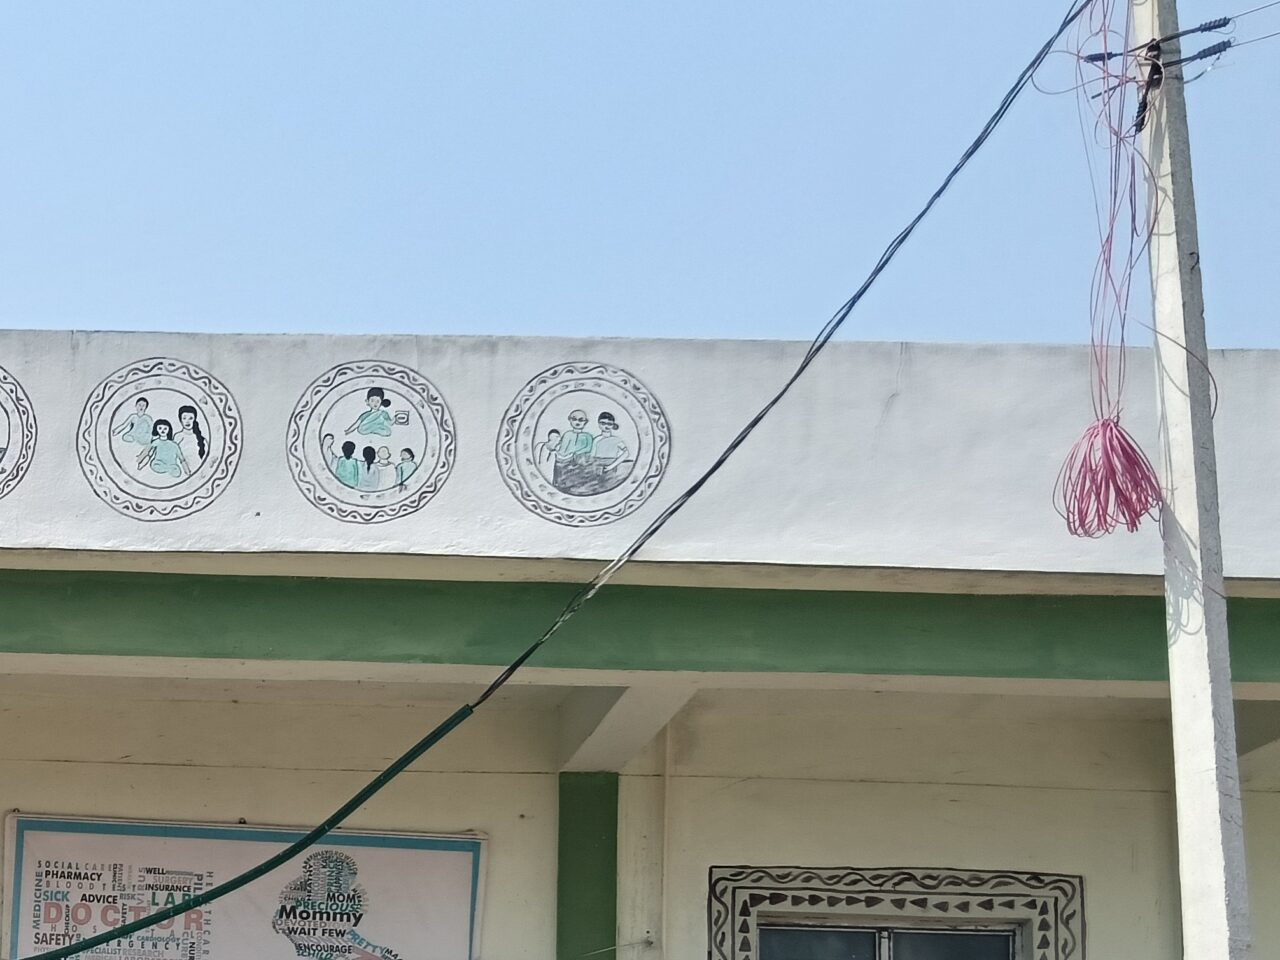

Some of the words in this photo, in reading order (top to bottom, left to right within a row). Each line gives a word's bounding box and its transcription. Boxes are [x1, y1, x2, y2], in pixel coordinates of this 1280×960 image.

[37, 860, 80, 871] SOCIAL
[44, 870, 103, 881] PHARMACY
[45, 880, 95, 890] BLOOD
[145, 884, 192, 892] INSURANCE
[32, 871, 43, 930] MEDICINE
[42, 890, 70, 902] SICK
[80, 893, 118, 904] ADVICE
[327, 893, 356, 903] MOM
[295, 902, 360, 913] PRECIOUS
[279, 905, 363, 927] Mommy
[276, 919, 327, 928] DEVOTED
[287, 927, 318, 936] WAIT
[322, 929, 346, 938] FEW
[346, 928, 386, 954] PRETTY
[299, 943, 353, 954] ENCOURAGE
